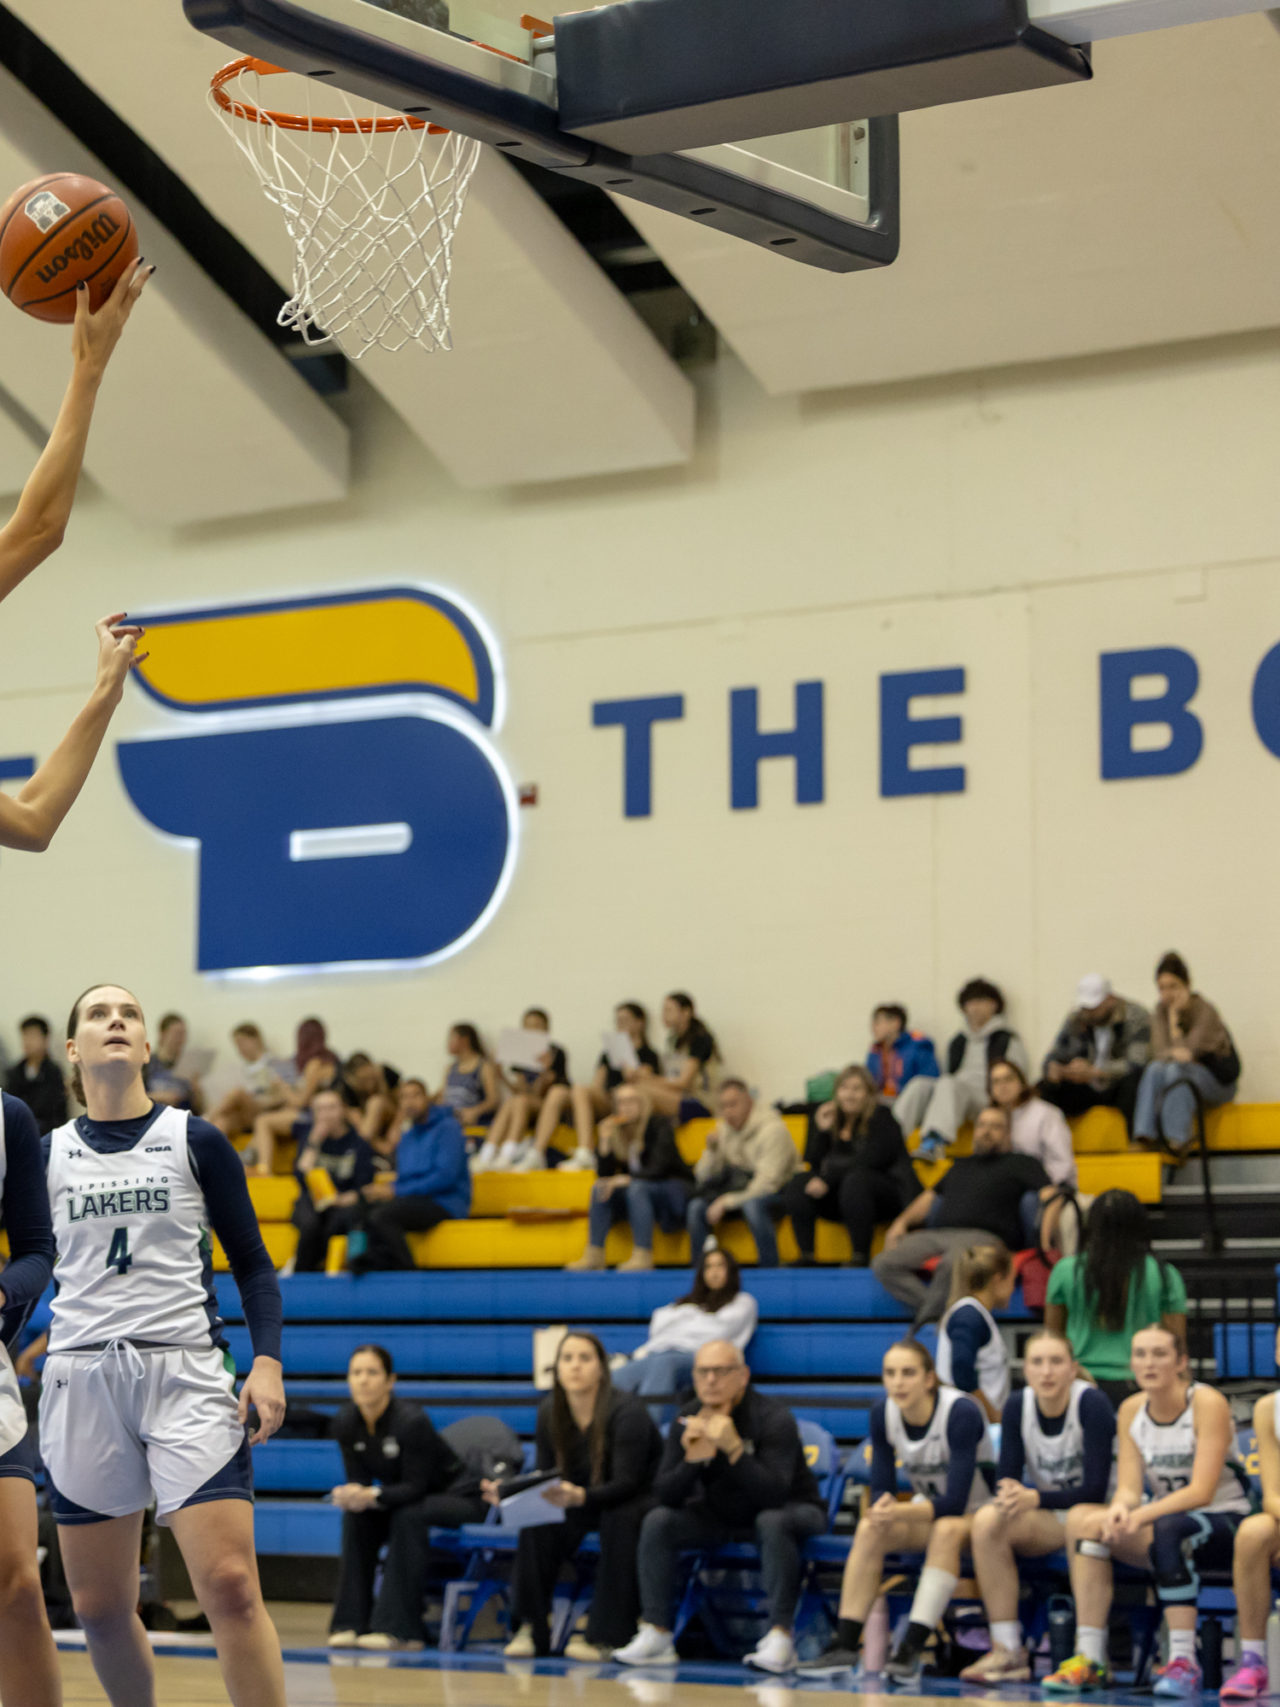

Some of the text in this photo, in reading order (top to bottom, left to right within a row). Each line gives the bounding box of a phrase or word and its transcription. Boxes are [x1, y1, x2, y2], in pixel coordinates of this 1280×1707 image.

[35, 212, 121, 284] Wilson
[592, 665, 967, 818] THE
[66, 1176, 169, 1194] NIPISSING
[66, 1187, 170, 1223] LAKERS
[106, 1227, 132, 1274] 4
